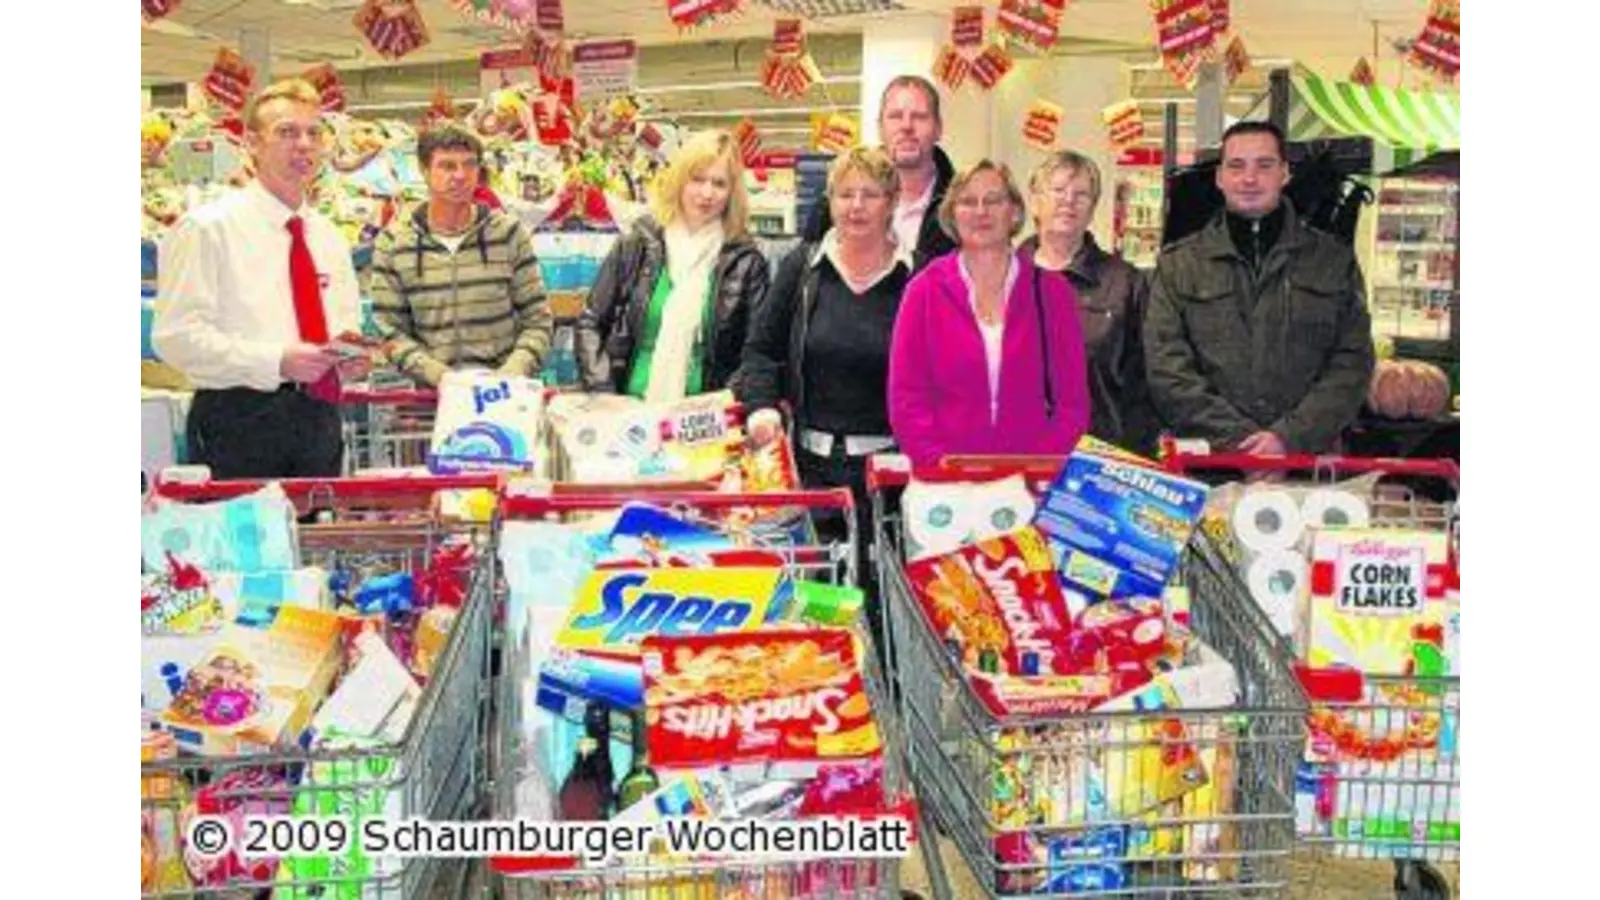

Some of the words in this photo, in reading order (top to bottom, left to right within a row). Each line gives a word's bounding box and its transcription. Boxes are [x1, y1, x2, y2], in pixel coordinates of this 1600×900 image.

[1350, 563, 1411, 585] CORN
[1340, 586, 1418, 607] FLAKES
[570, 573, 752, 643] Spee
